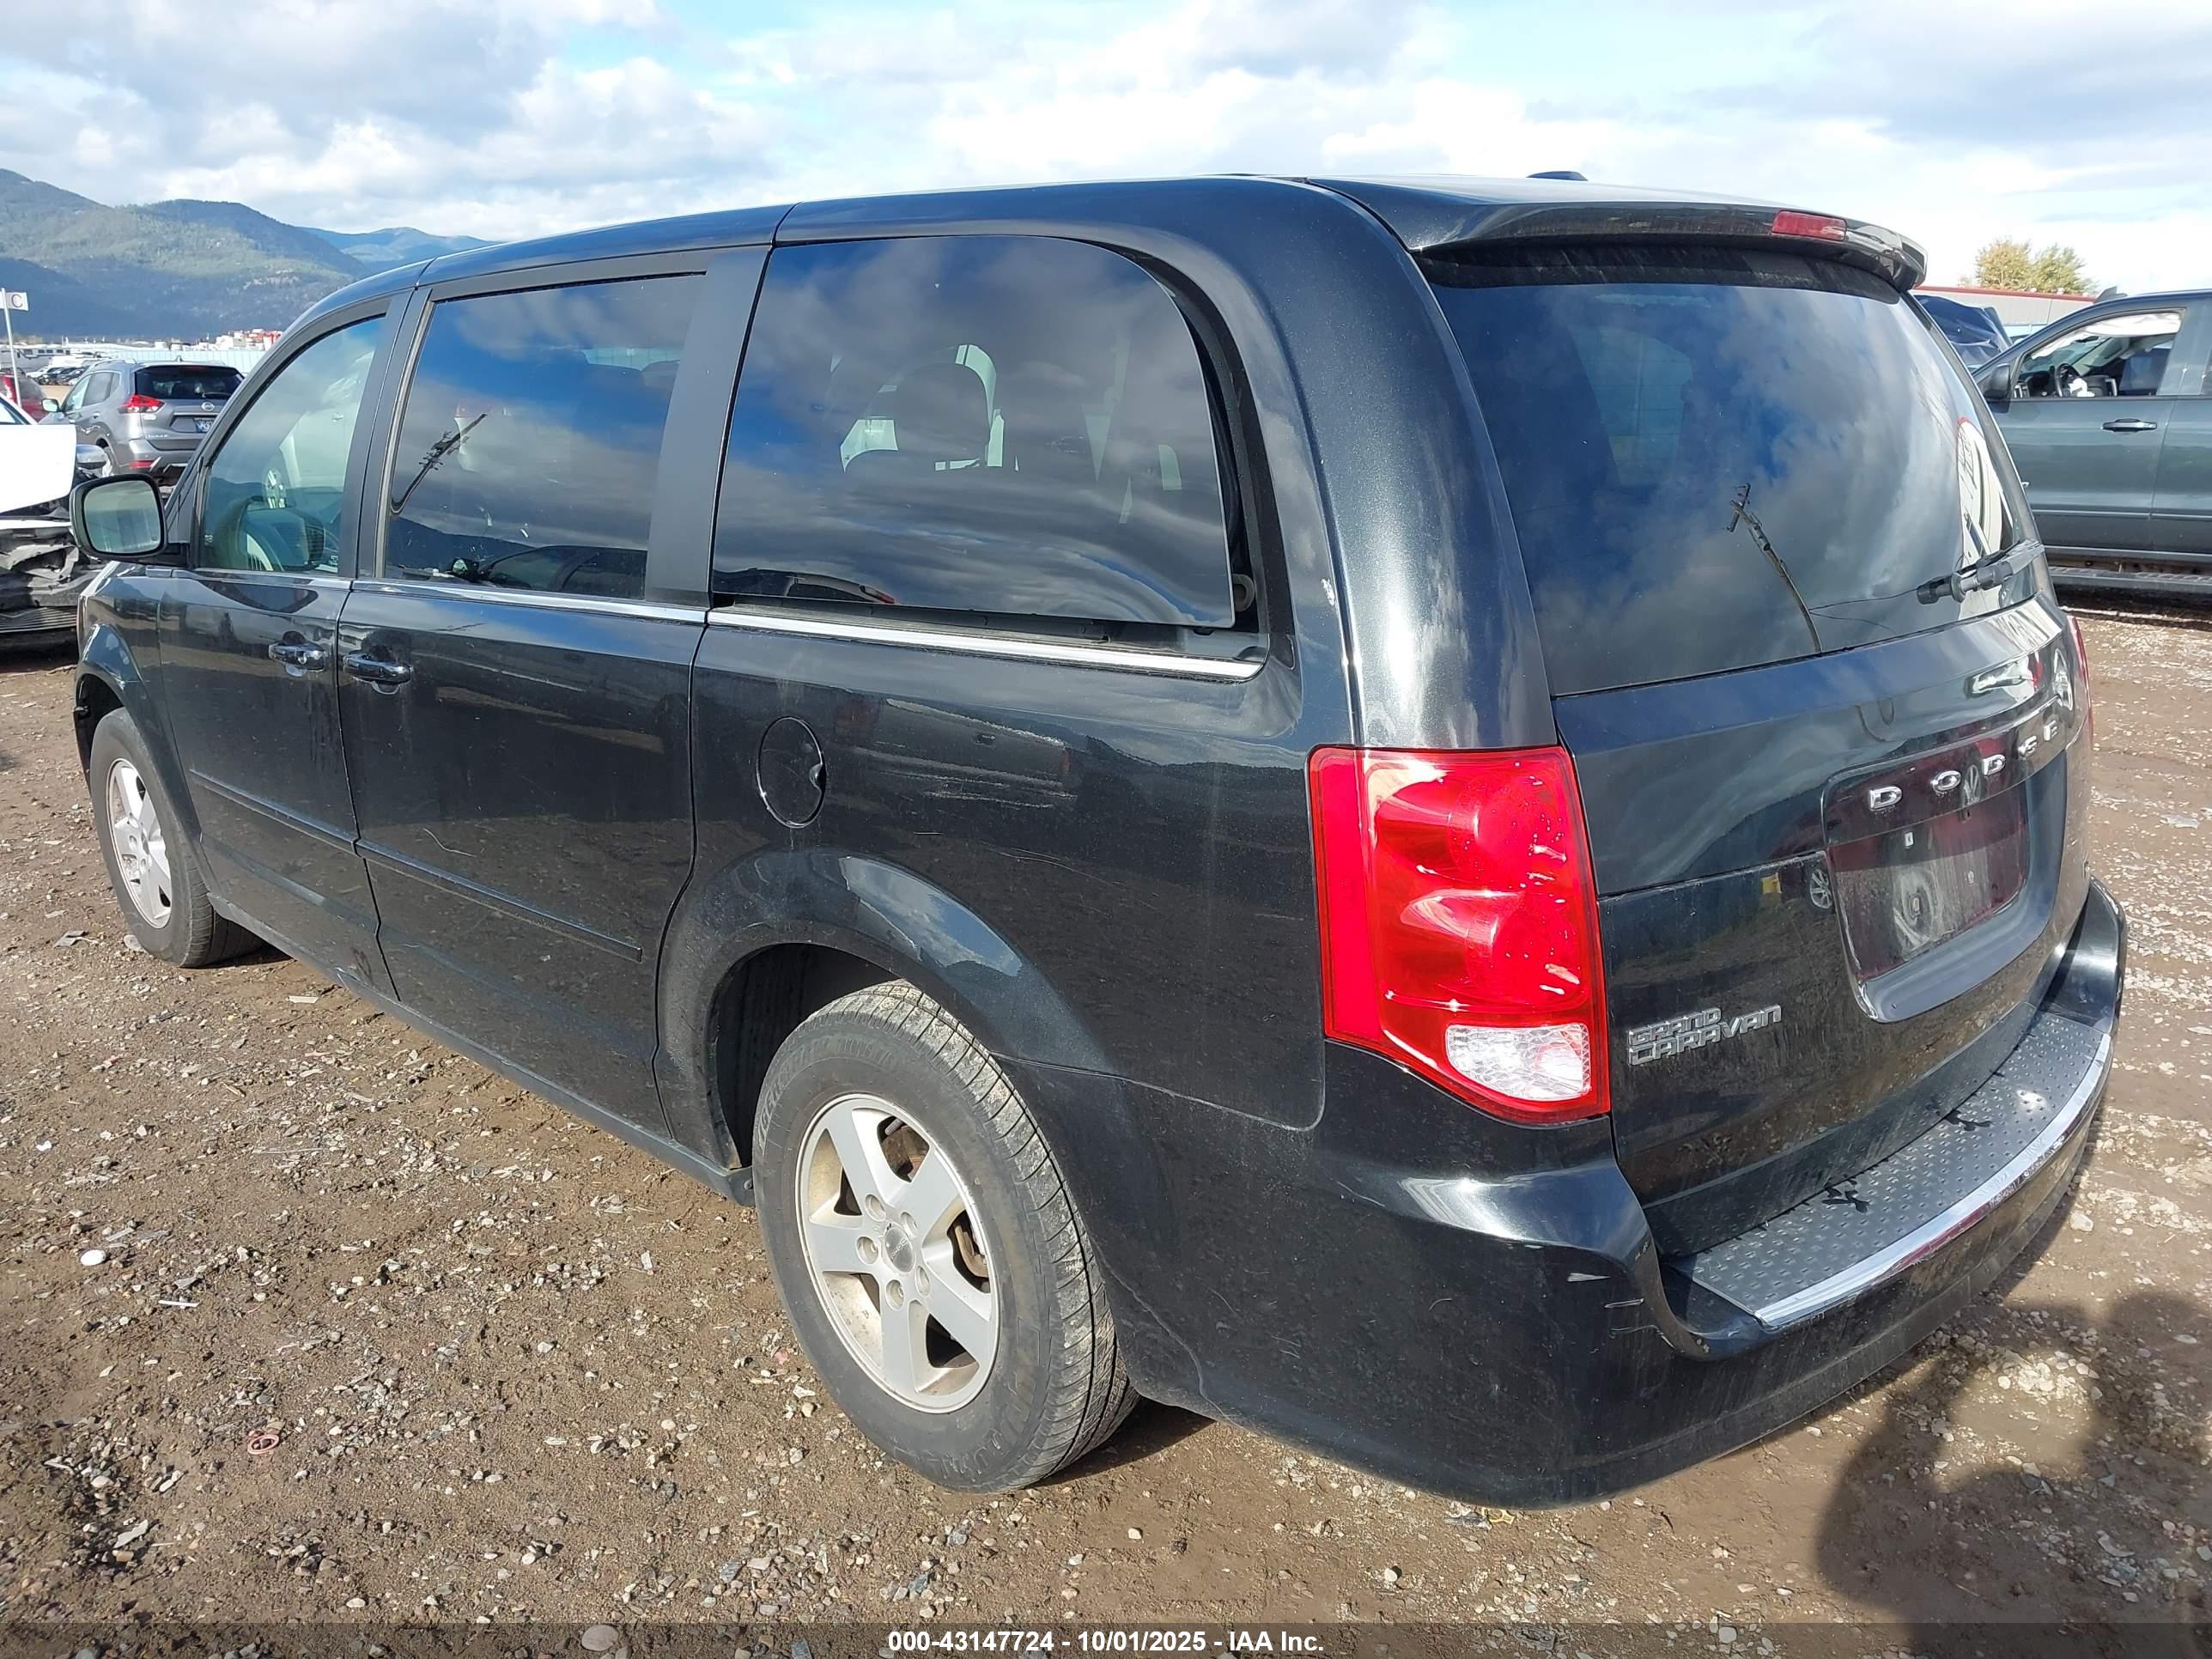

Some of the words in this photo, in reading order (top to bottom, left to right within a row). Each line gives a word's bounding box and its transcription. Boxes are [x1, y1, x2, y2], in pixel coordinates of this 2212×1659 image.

[11, 294, 23, 307] C
[1868, 720, 2059, 811] DODGE
[1628, 1006, 1722, 1046] GRAND
[1628, 1004, 1782, 1066] CARAVAN
